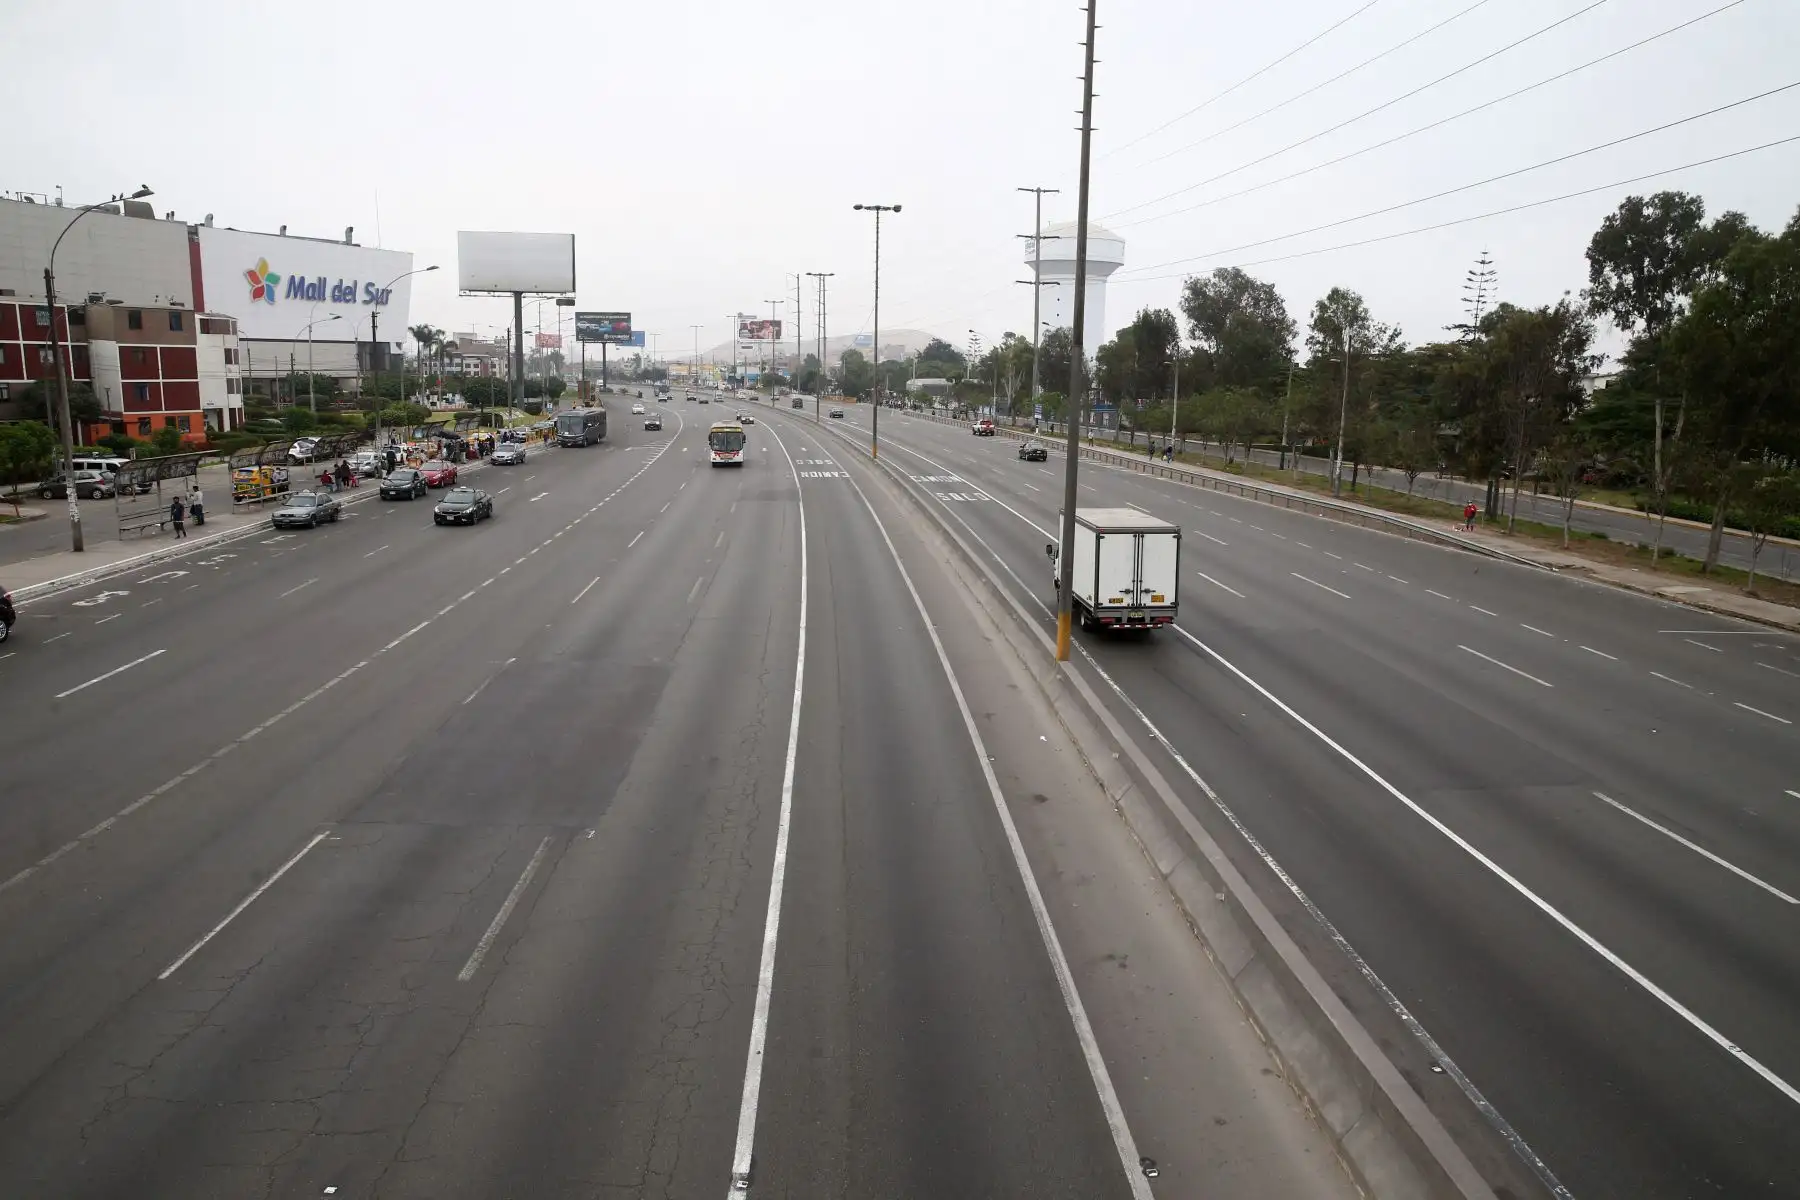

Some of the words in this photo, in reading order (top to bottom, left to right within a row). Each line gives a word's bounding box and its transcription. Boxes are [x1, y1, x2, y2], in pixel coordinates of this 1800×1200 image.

[285, 275, 327, 301] Mall
[332, 278, 358, 304] del
[362, 281, 393, 306] Sur
[935, 492, 991, 501] SOLO
